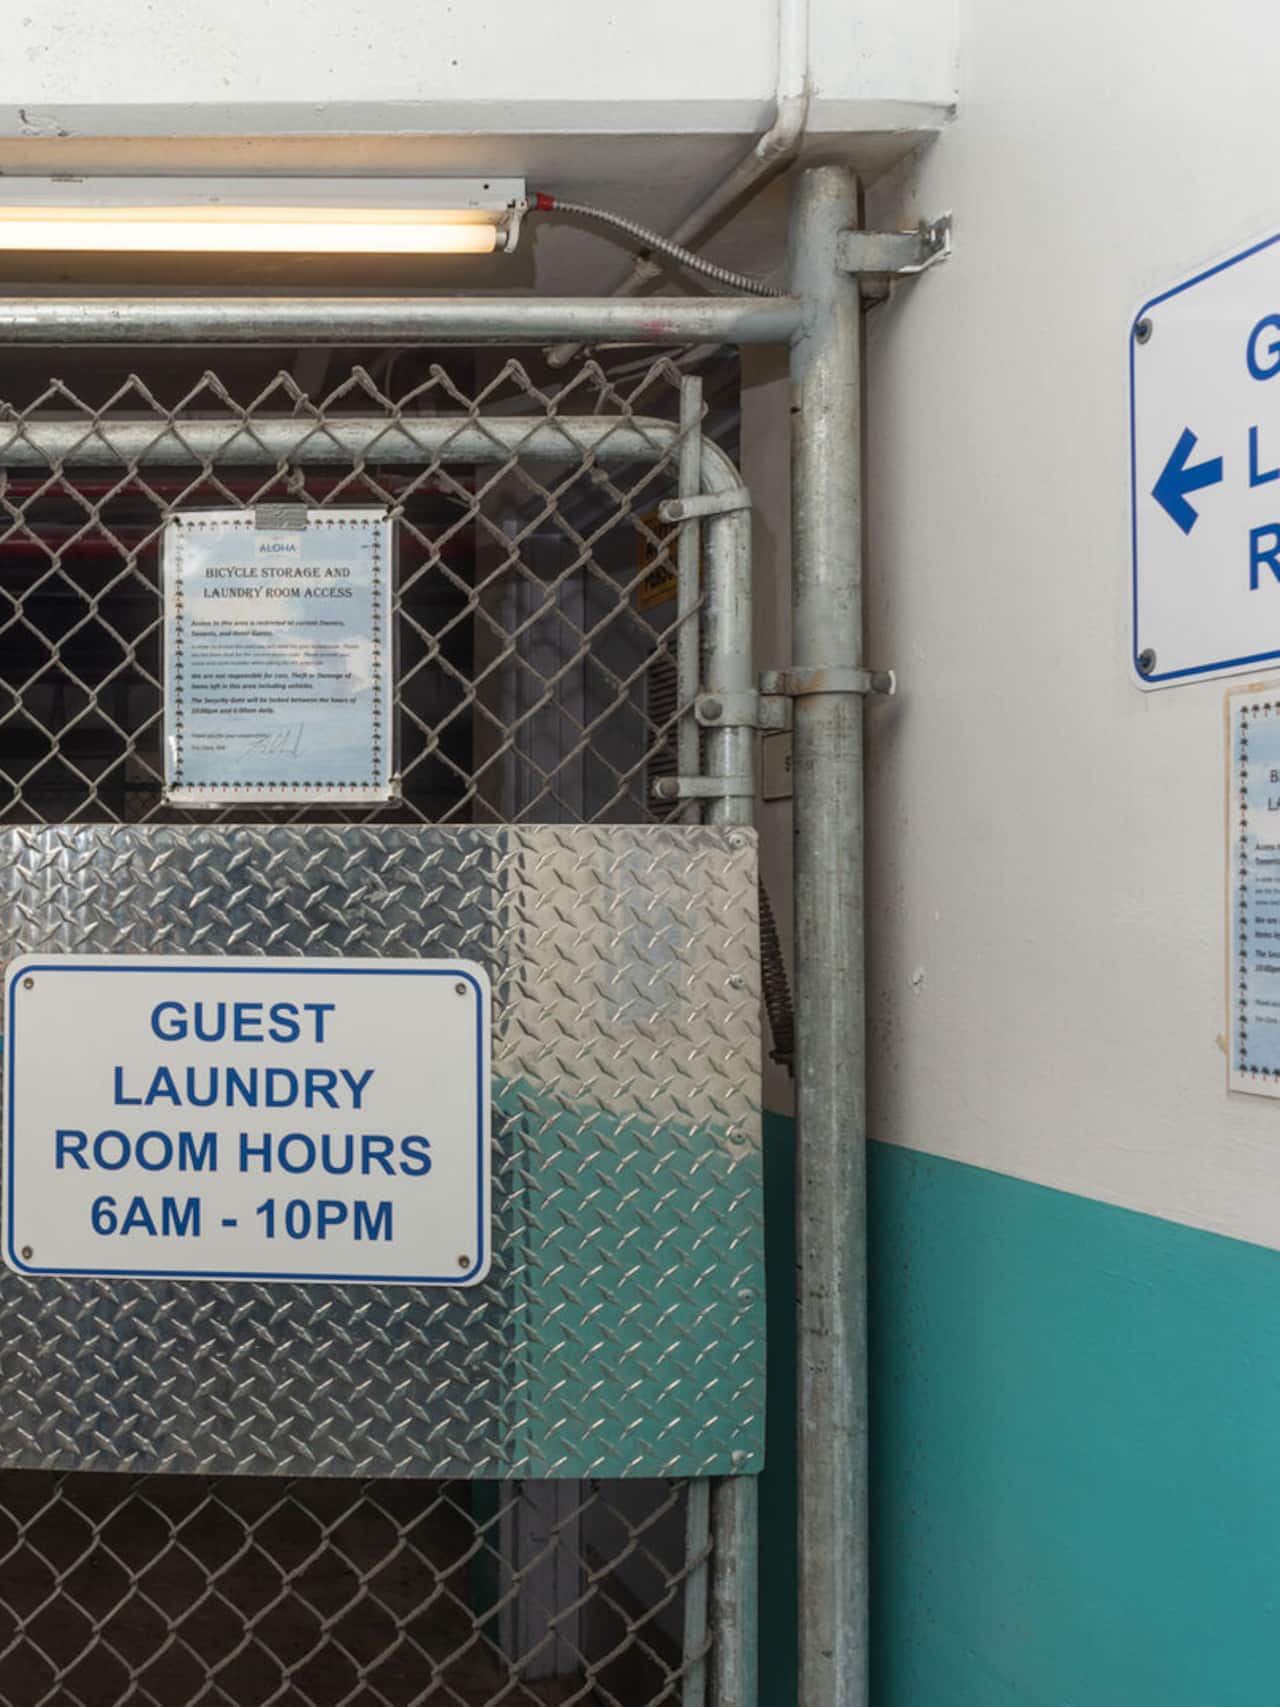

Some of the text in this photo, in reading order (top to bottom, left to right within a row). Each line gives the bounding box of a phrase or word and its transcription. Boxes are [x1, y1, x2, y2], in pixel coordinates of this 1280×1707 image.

[259, 543, 297, 552] ALOHA
[203, 586, 353, 598] LAUNDRY ROOM ACCESS
[205, 566, 351, 578] BICYCLE STORAGE AND
[150, 1001, 335, 1043] GUEST
[114, 1066, 375, 1109] LAUNDRY
[55, 1129, 432, 1177] ROOM HOURS
[90, 1195, 393, 1242] 6AM - 10PM
